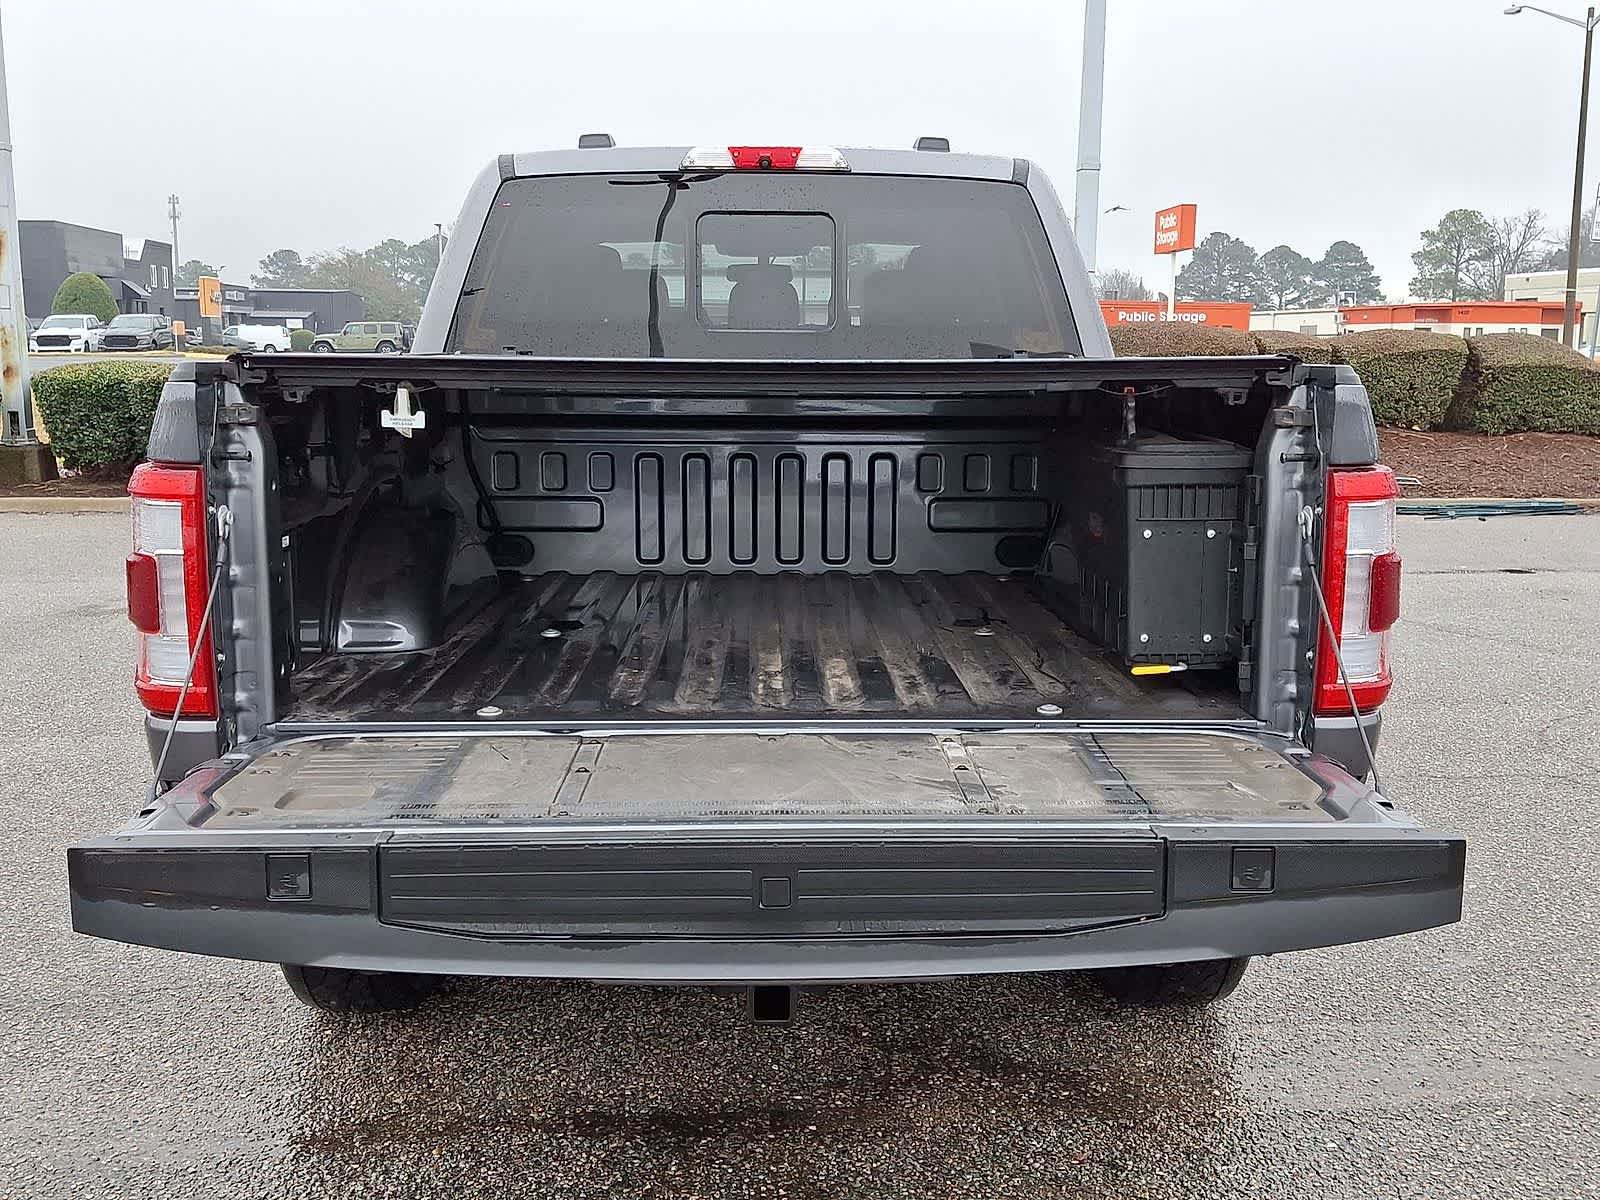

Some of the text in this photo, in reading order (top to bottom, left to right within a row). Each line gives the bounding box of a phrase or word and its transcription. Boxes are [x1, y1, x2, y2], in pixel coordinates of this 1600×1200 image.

[1160, 212, 1177, 230] Public
[1156, 229, 1179, 246] Storage
[1118, 311, 1207, 324] Public Sorage
